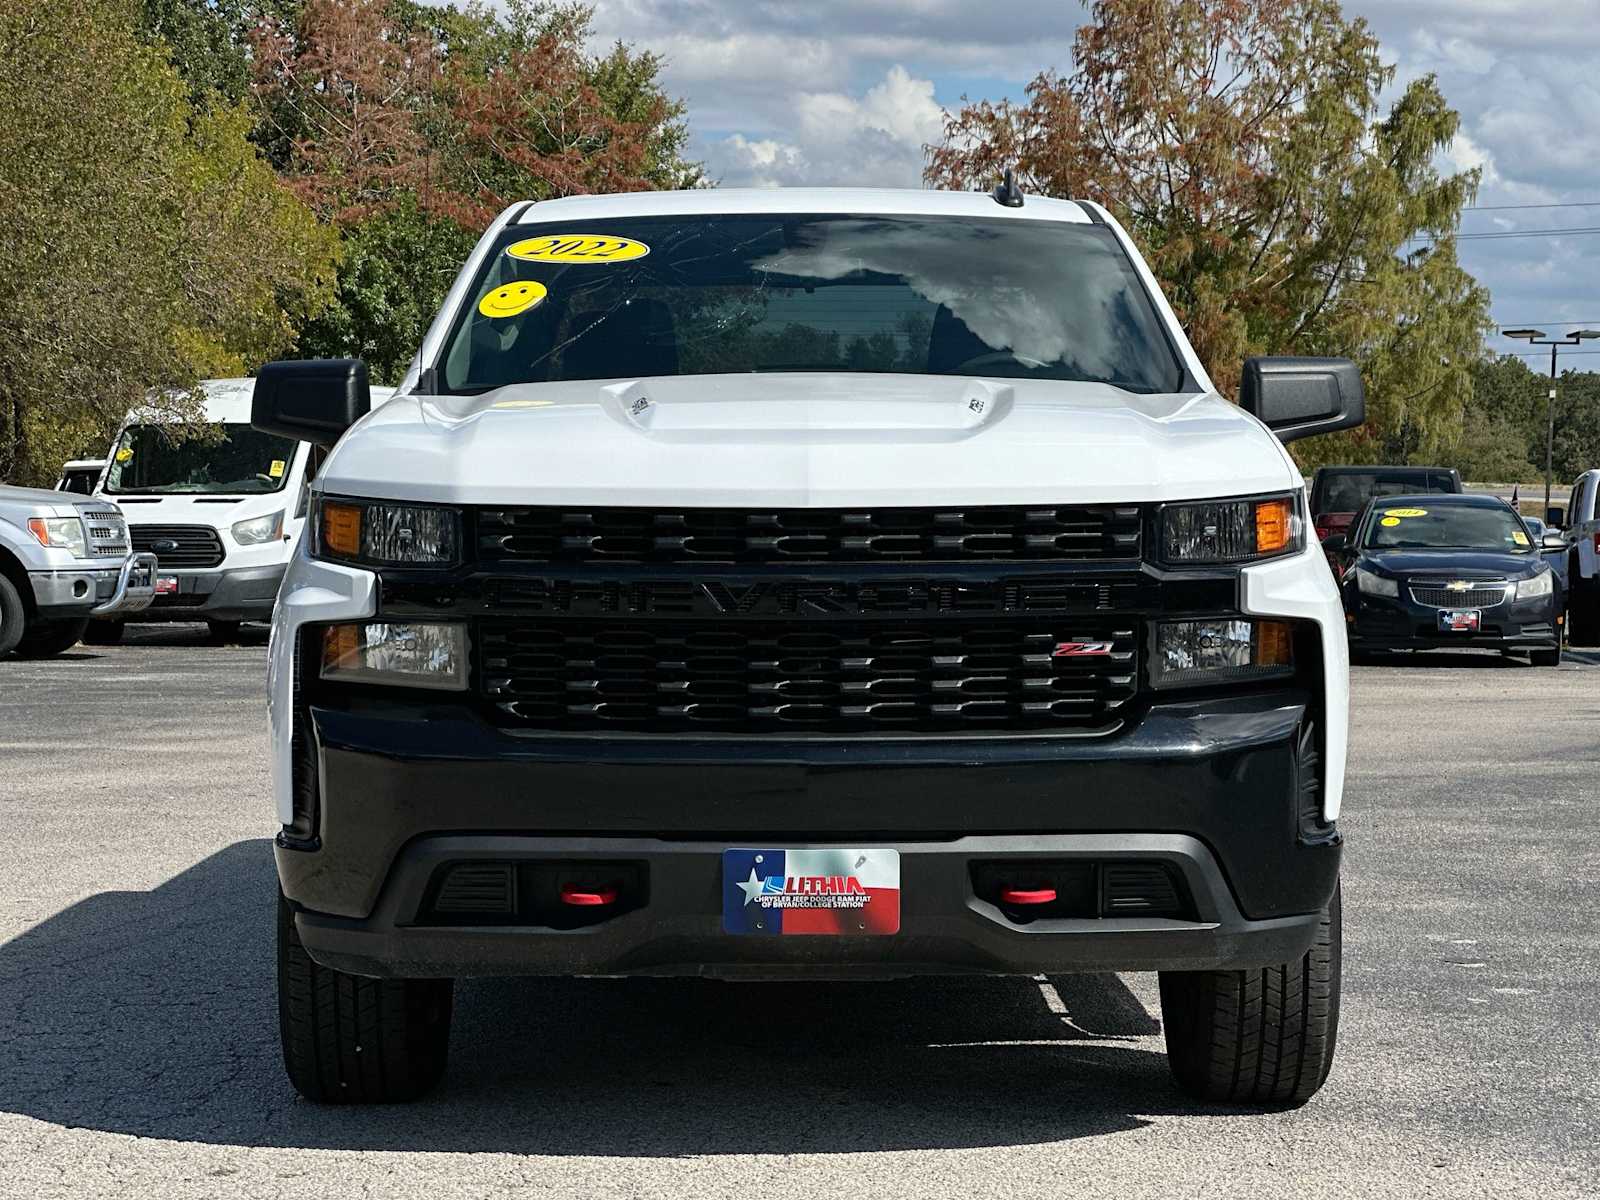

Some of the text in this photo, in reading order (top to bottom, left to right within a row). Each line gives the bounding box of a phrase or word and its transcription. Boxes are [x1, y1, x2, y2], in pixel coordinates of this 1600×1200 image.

[526, 240, 628, 256] 2022
[484, 578, 1135, 613] CHEVROLET
[784, 876, 866, 895] LITHIA
